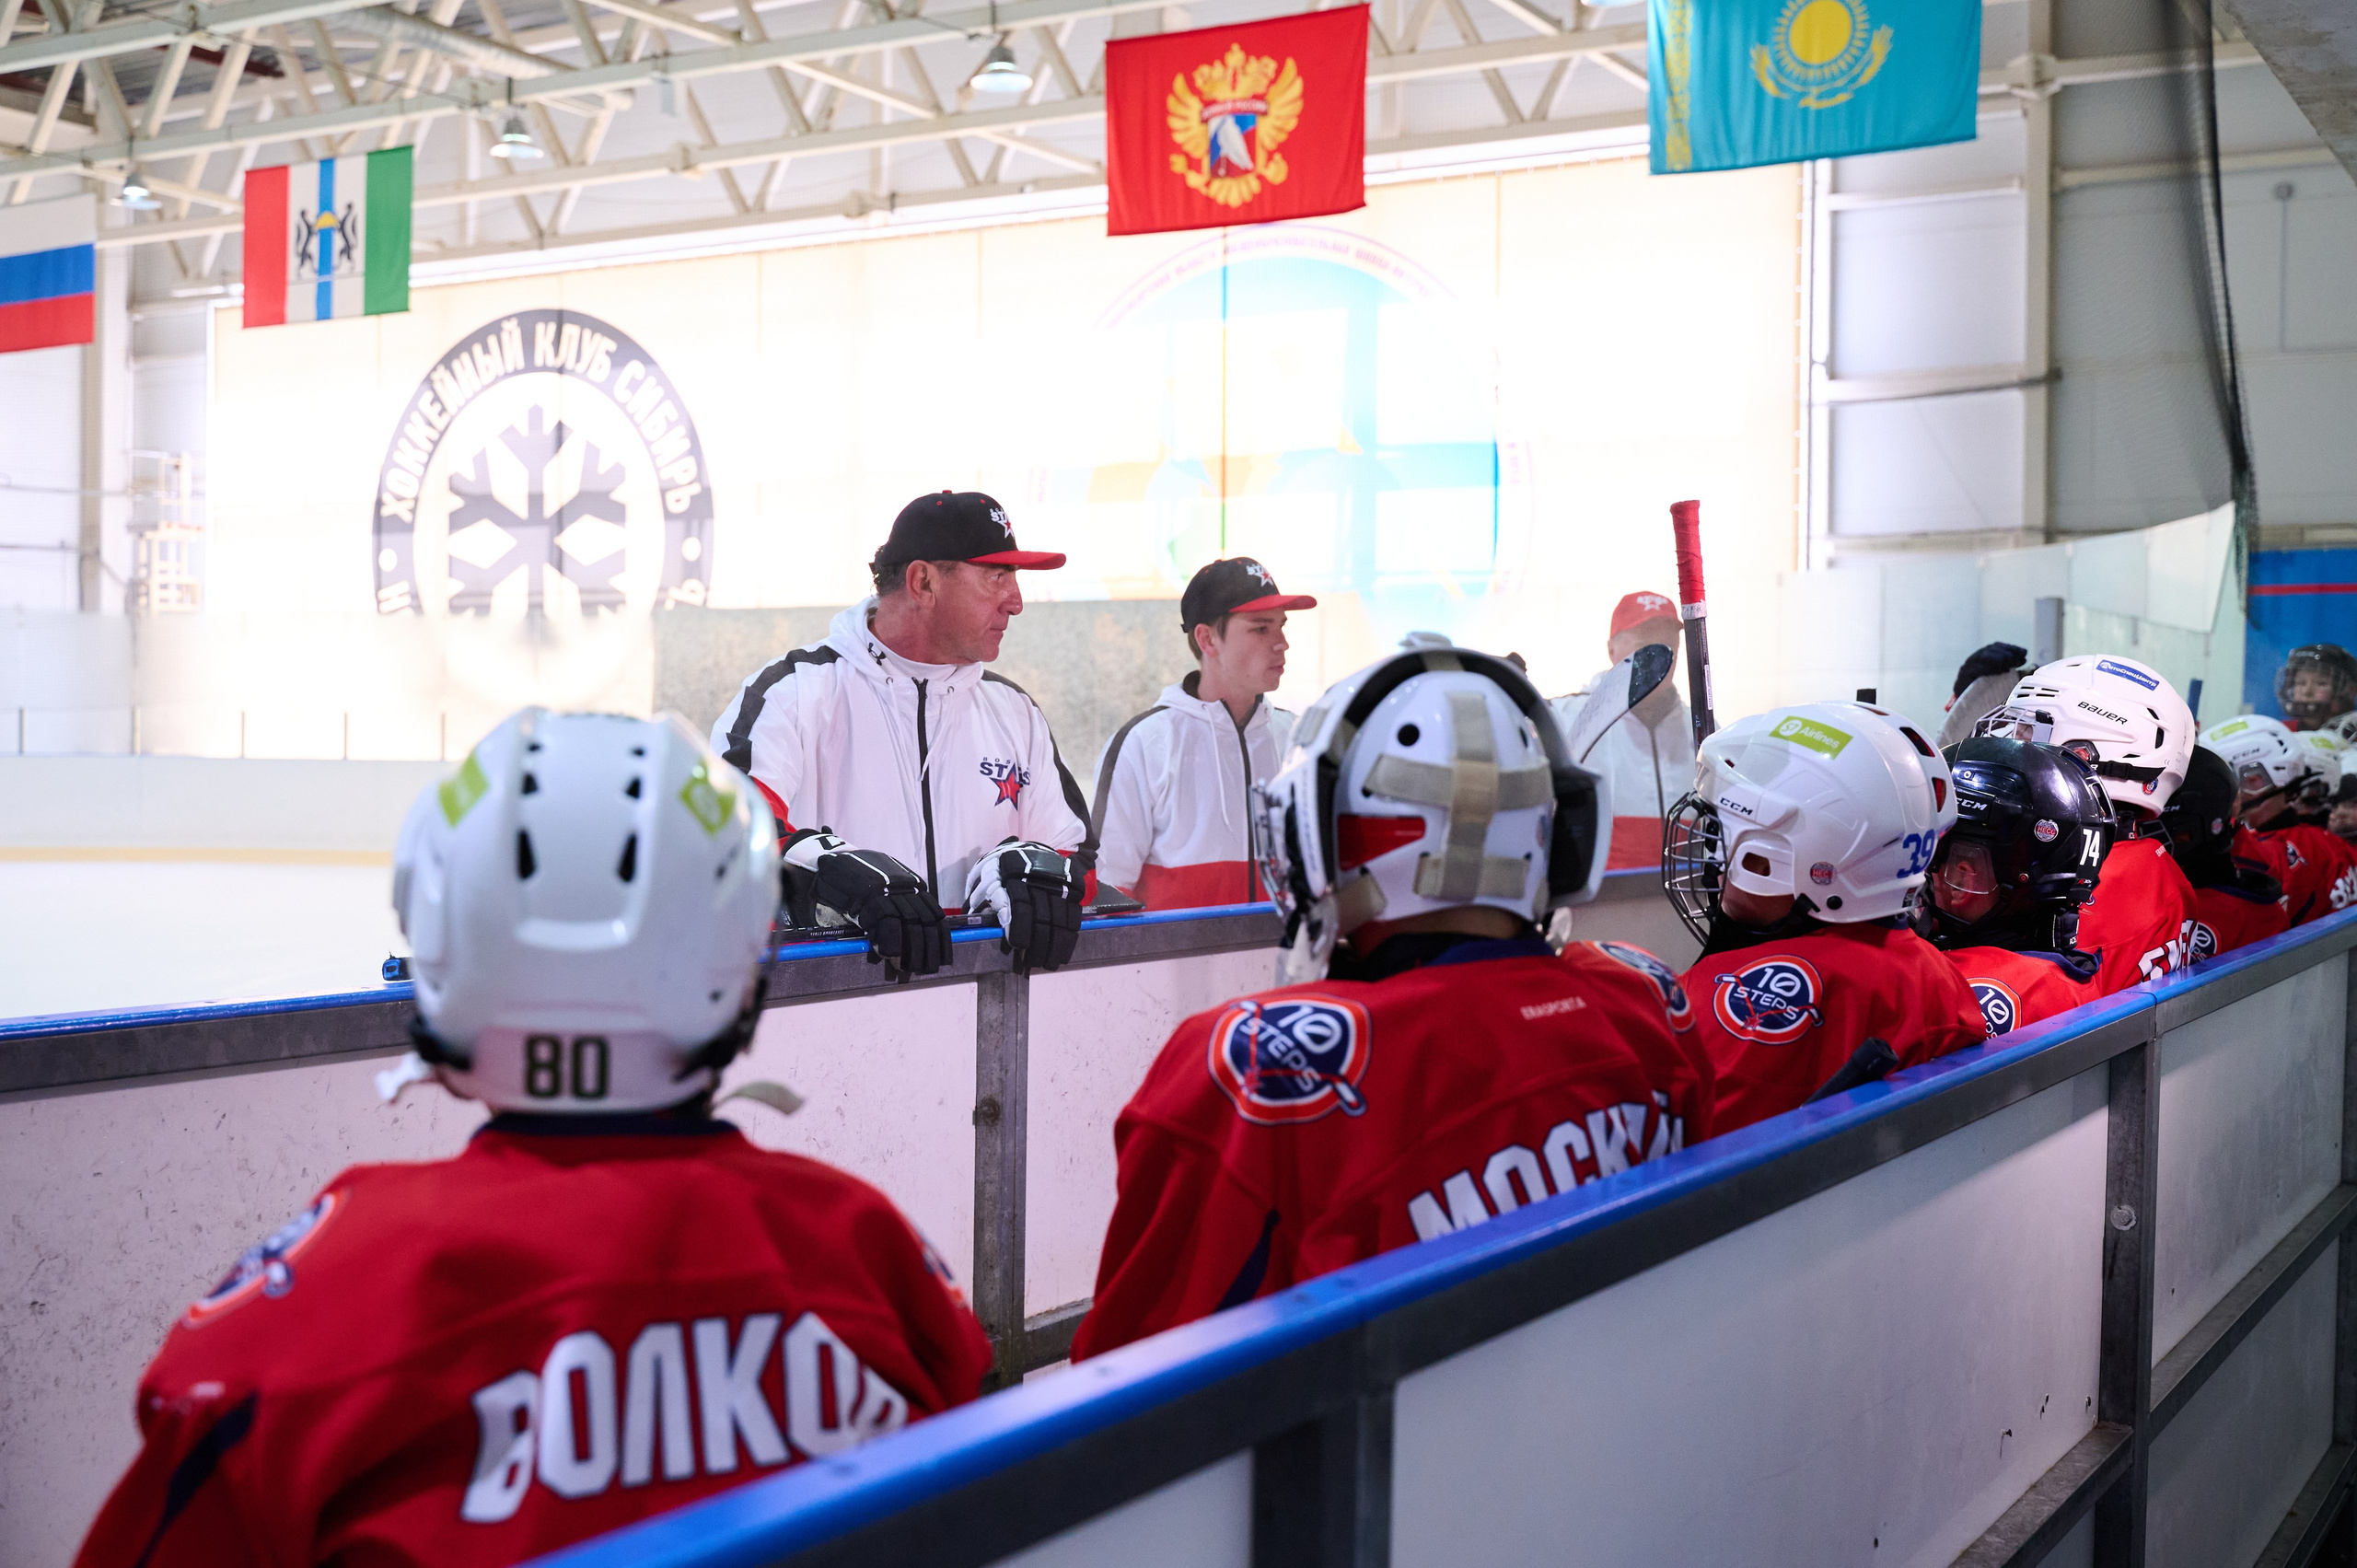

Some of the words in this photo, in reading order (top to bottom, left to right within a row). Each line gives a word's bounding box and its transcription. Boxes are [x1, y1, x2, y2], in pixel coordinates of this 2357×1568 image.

[380, 318, 526, 524] ХОККЕЙНЫЙ
[534, 321, 618, 383] КЛУБ
[613, 359, 702, 515] СИБИРЬ
[1798, 726, 1840, 749] Airlines
[1719, 796, 1753, 816] CCM
[1897, 829, 1935, 878] 39
[2079, 828, 2100, 867] 74
[1757, 967, 1802, 997] 10
[1733, 986, 1800, 1020] STEPS
[1979, 988, 2010, 1025] 10
[1277, 1005, 1343, 1054] 10
[524, 1033, 611, 1099] 80
[1238, 1016, 1322, 1093] STEPS
